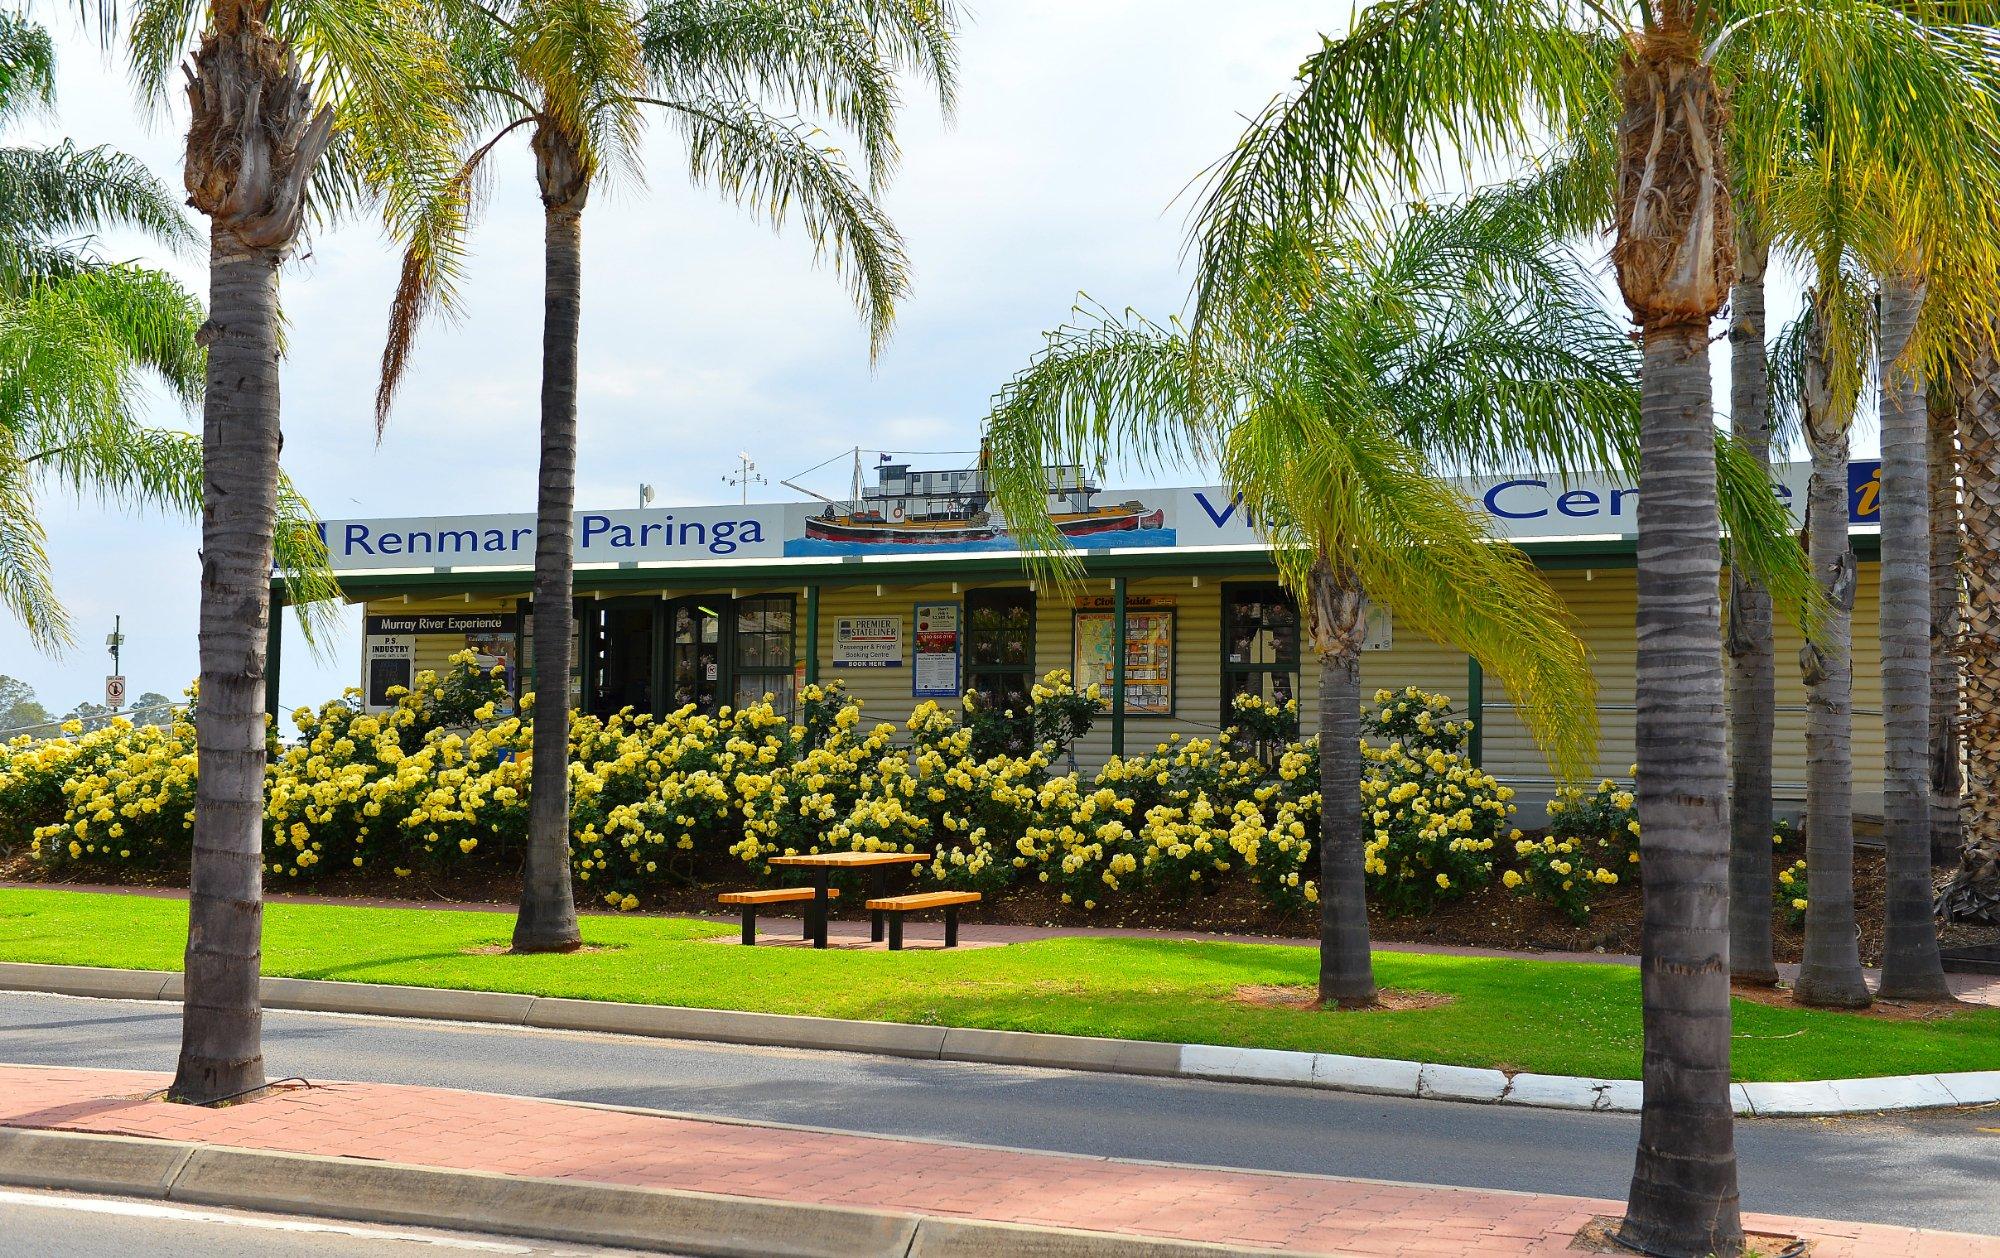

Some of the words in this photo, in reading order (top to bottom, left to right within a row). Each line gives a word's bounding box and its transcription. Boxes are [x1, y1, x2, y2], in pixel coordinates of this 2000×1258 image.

[344, 523, 533, 555] Renmar
[581, 514, 766, 555] Paringa
[1094, 596, 1116, 606] Civi
[381, 618, 416, 632] Murray
[419, 617, 446, 630] River
[448, 616, 502, 632] Experience
[856, 620, 891, 628] PREMIER
[851, 628, 896, 636] STATELINER
[840, 644, 870, 652] Passenger
[876, 643, 896, 651] Freight
